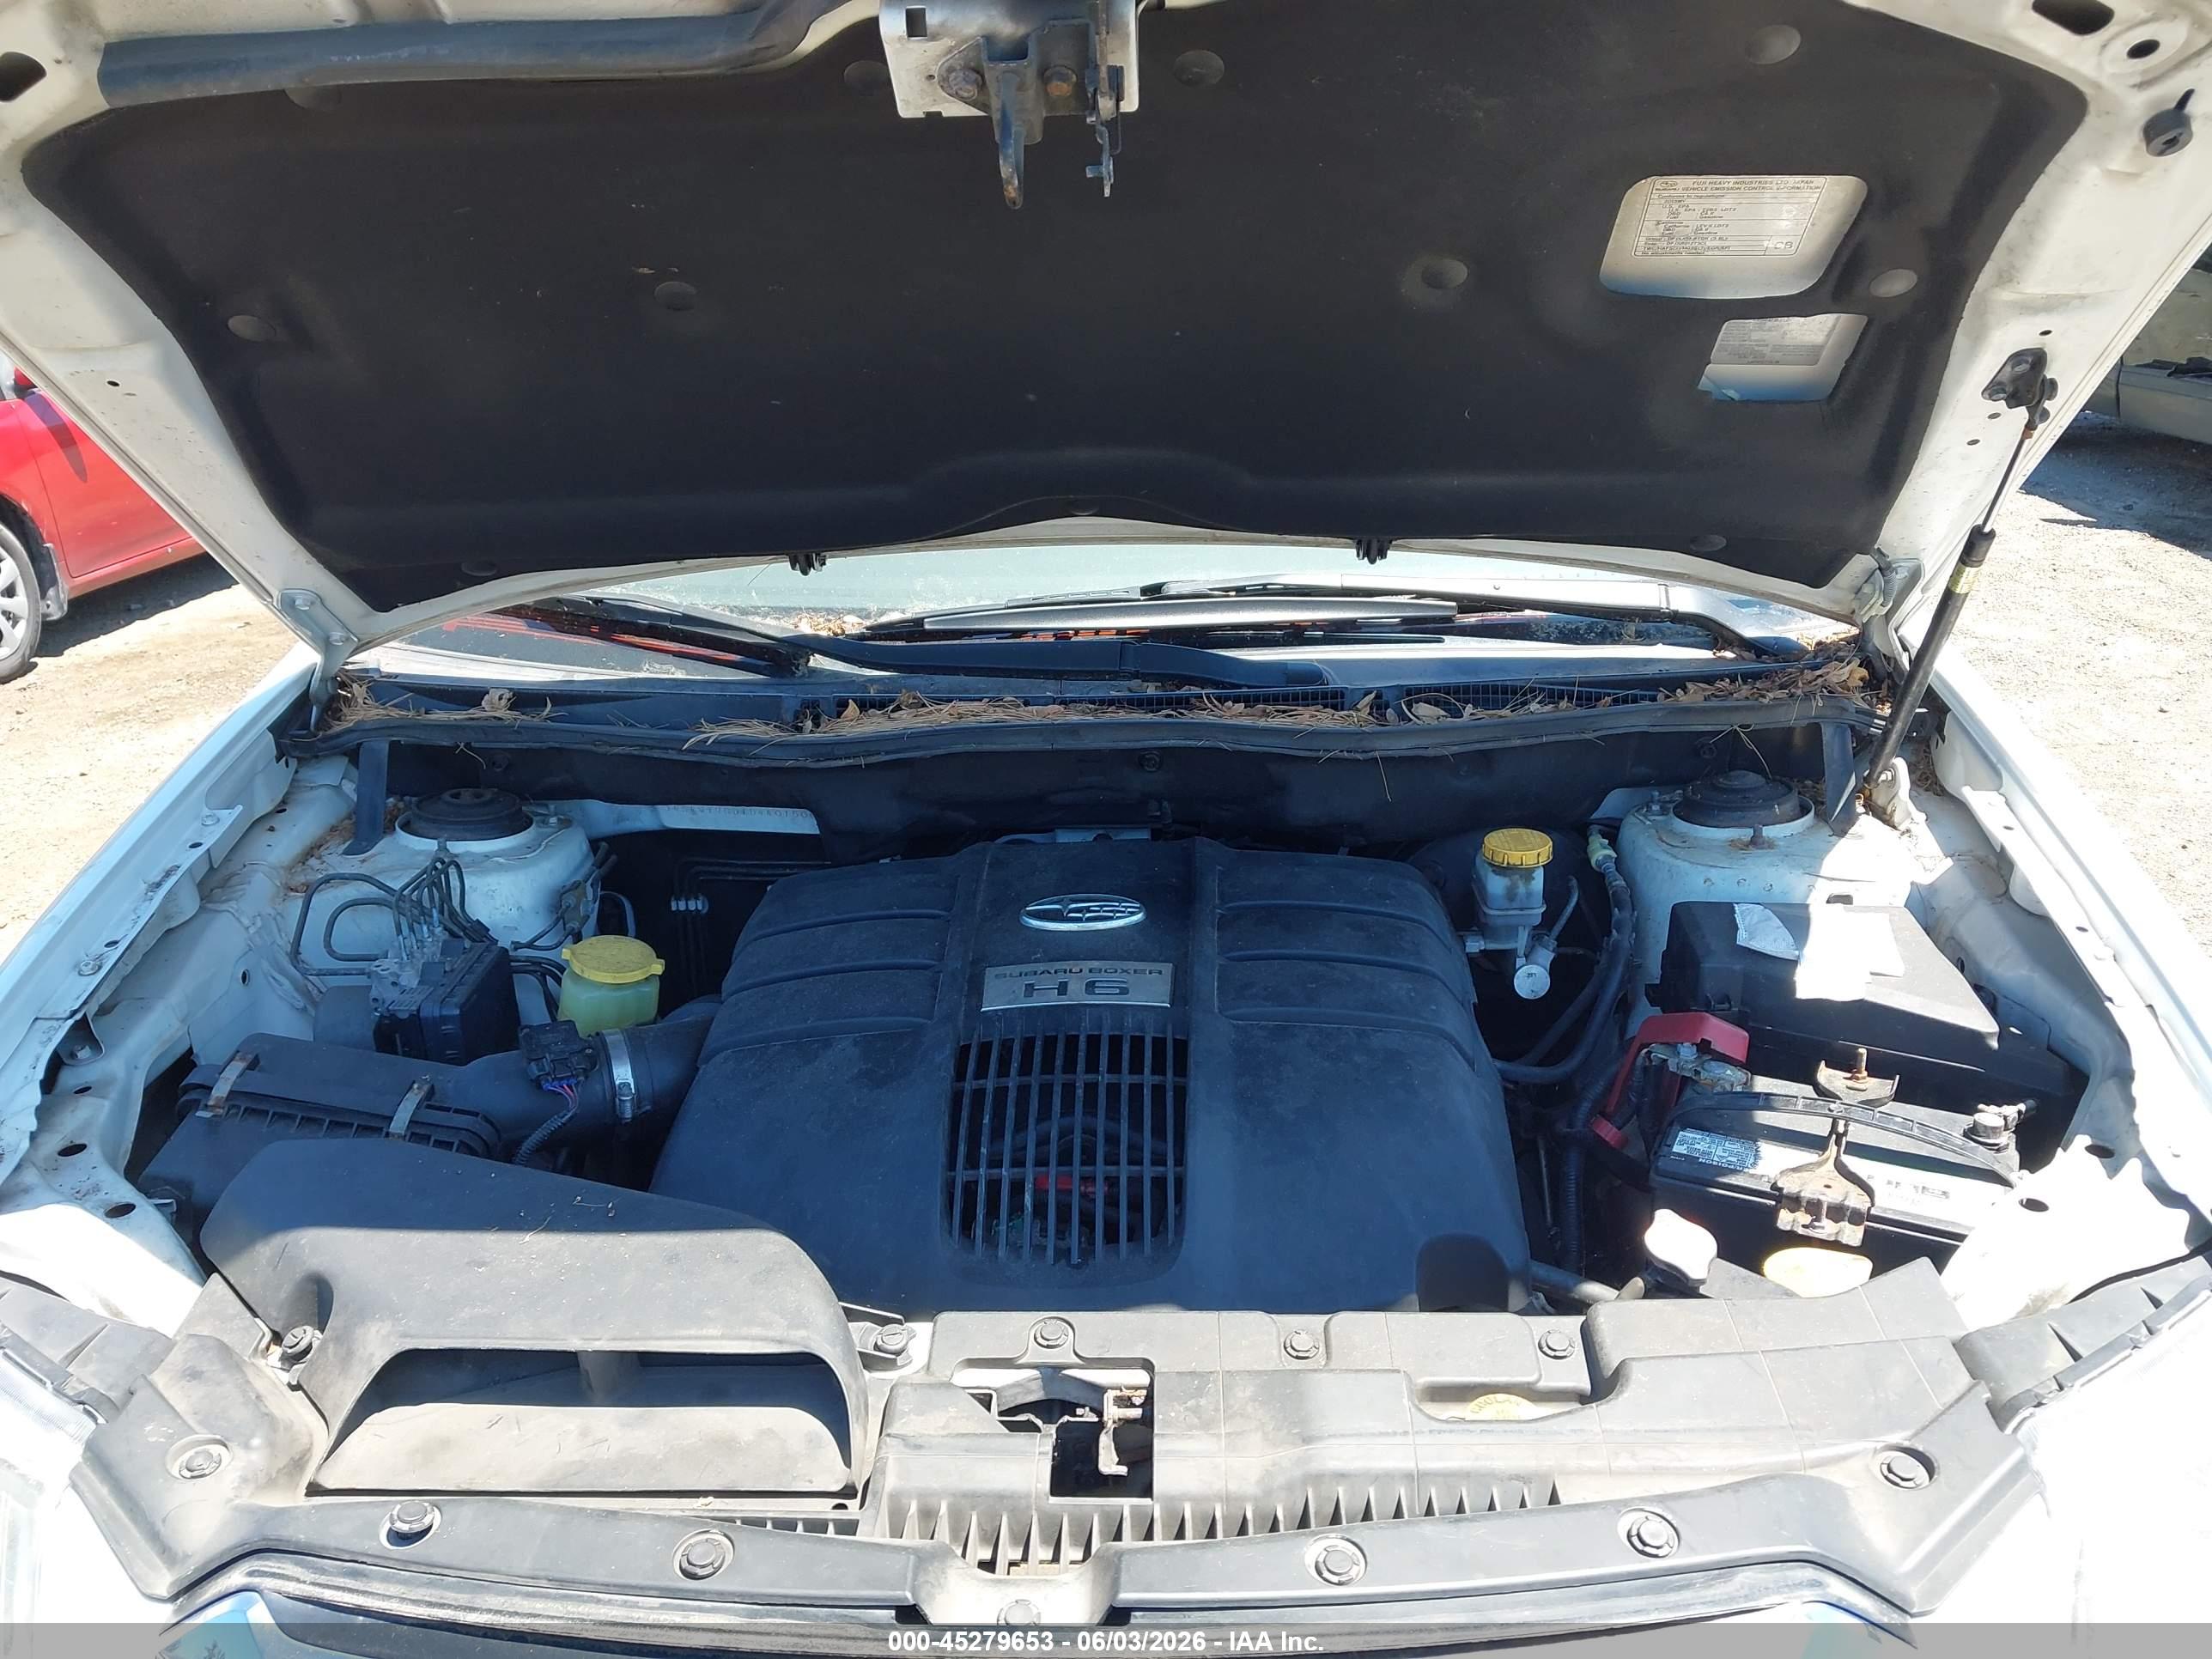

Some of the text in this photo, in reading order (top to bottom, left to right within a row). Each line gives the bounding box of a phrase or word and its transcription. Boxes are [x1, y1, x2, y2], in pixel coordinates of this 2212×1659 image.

[994, 967, 1164, 979] SUBARU BOXER
[1023, 979, 1130, 998] H6
